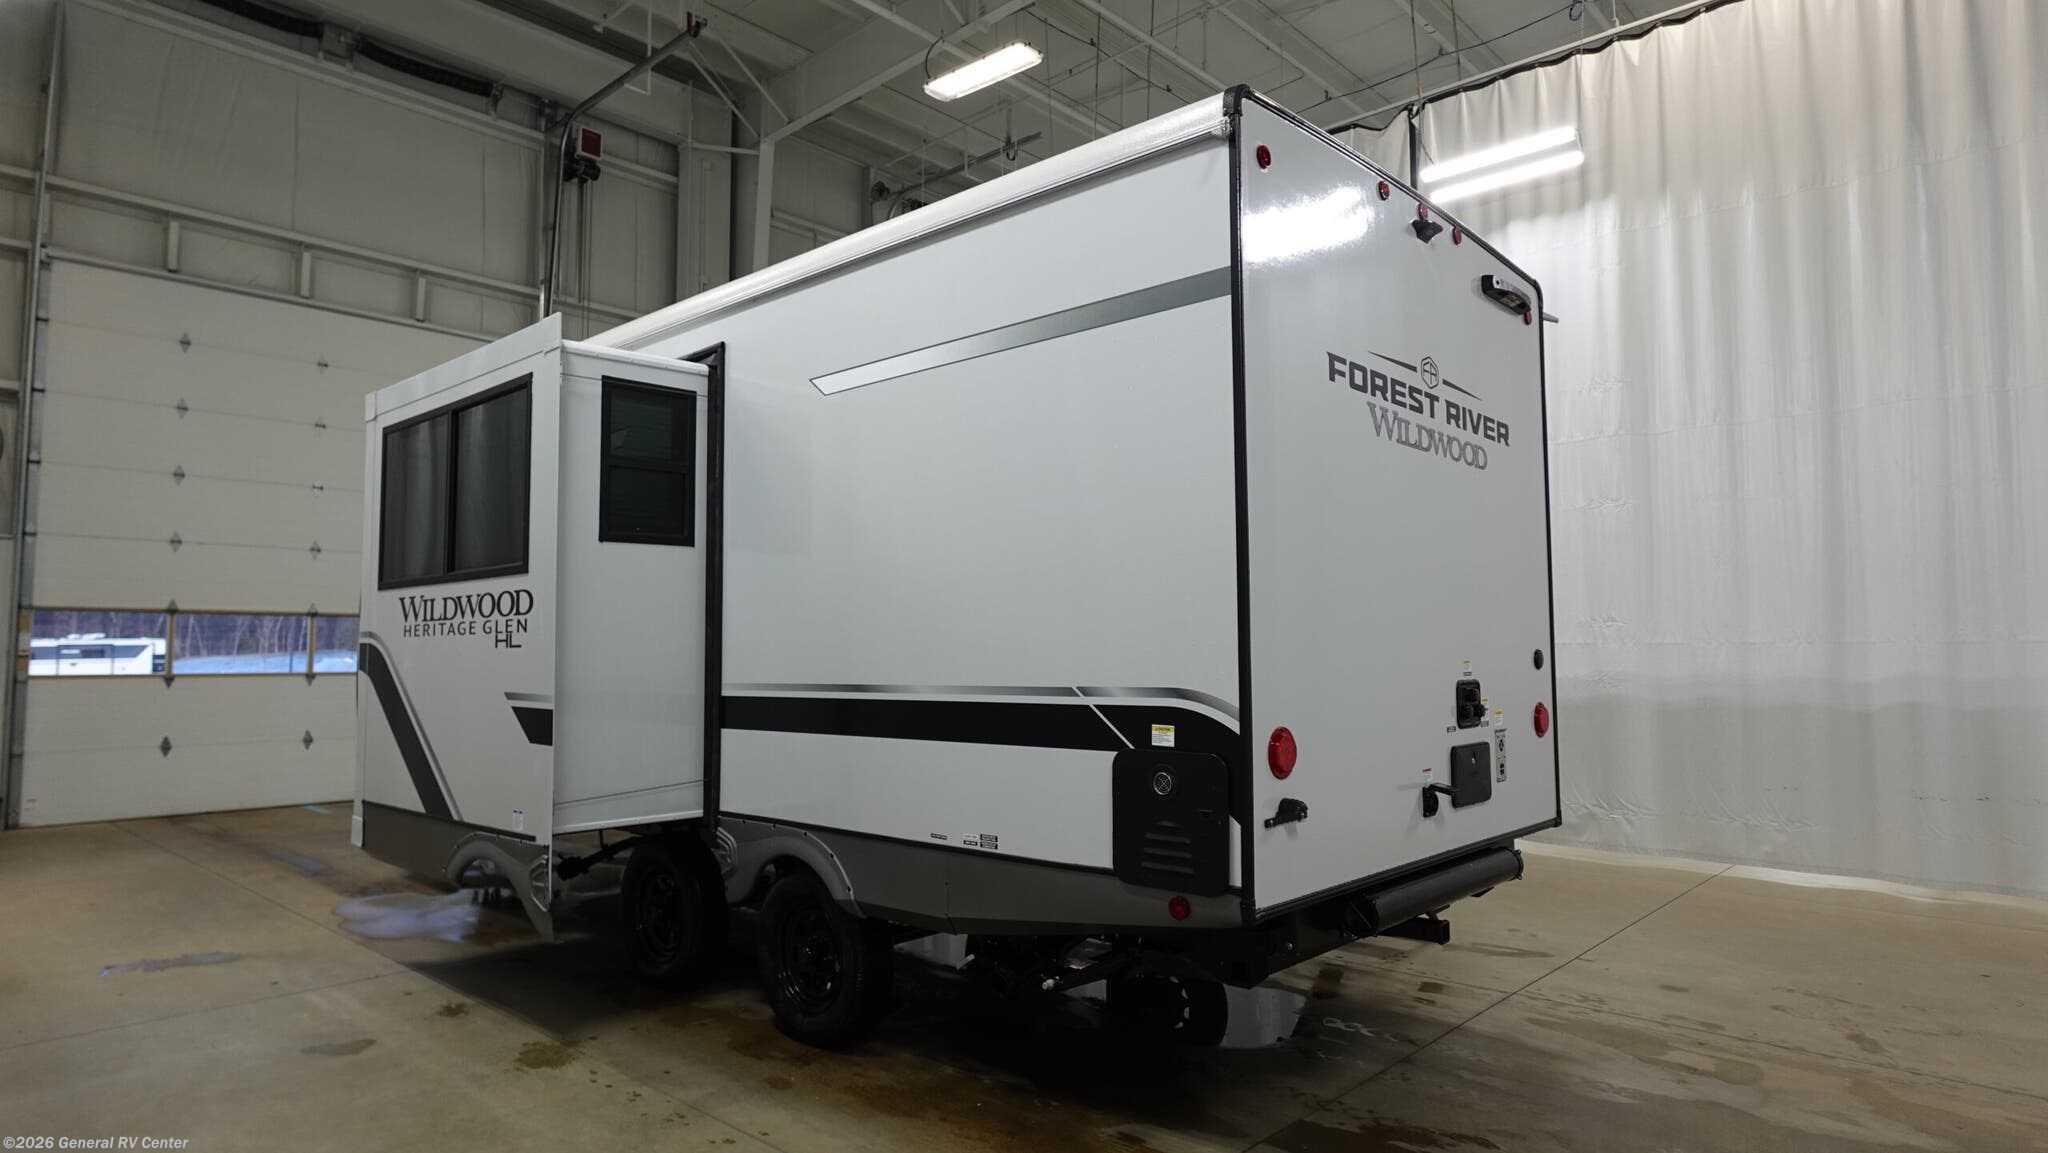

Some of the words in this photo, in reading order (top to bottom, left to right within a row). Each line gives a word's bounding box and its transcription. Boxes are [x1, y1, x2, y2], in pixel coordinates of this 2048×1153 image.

[1326, 351, 1440, 420] FOREST
[1444, 399, 1511, 448] RIVER
[1366, 401, 1489, 471] WILDWOOD
[398, 589, 534, 623] WILDWOOD
[403, 621, 477, 638] HERITAGE
[482, 618, 528, 635] GLEN
[495, 631, 522, 649] HL
